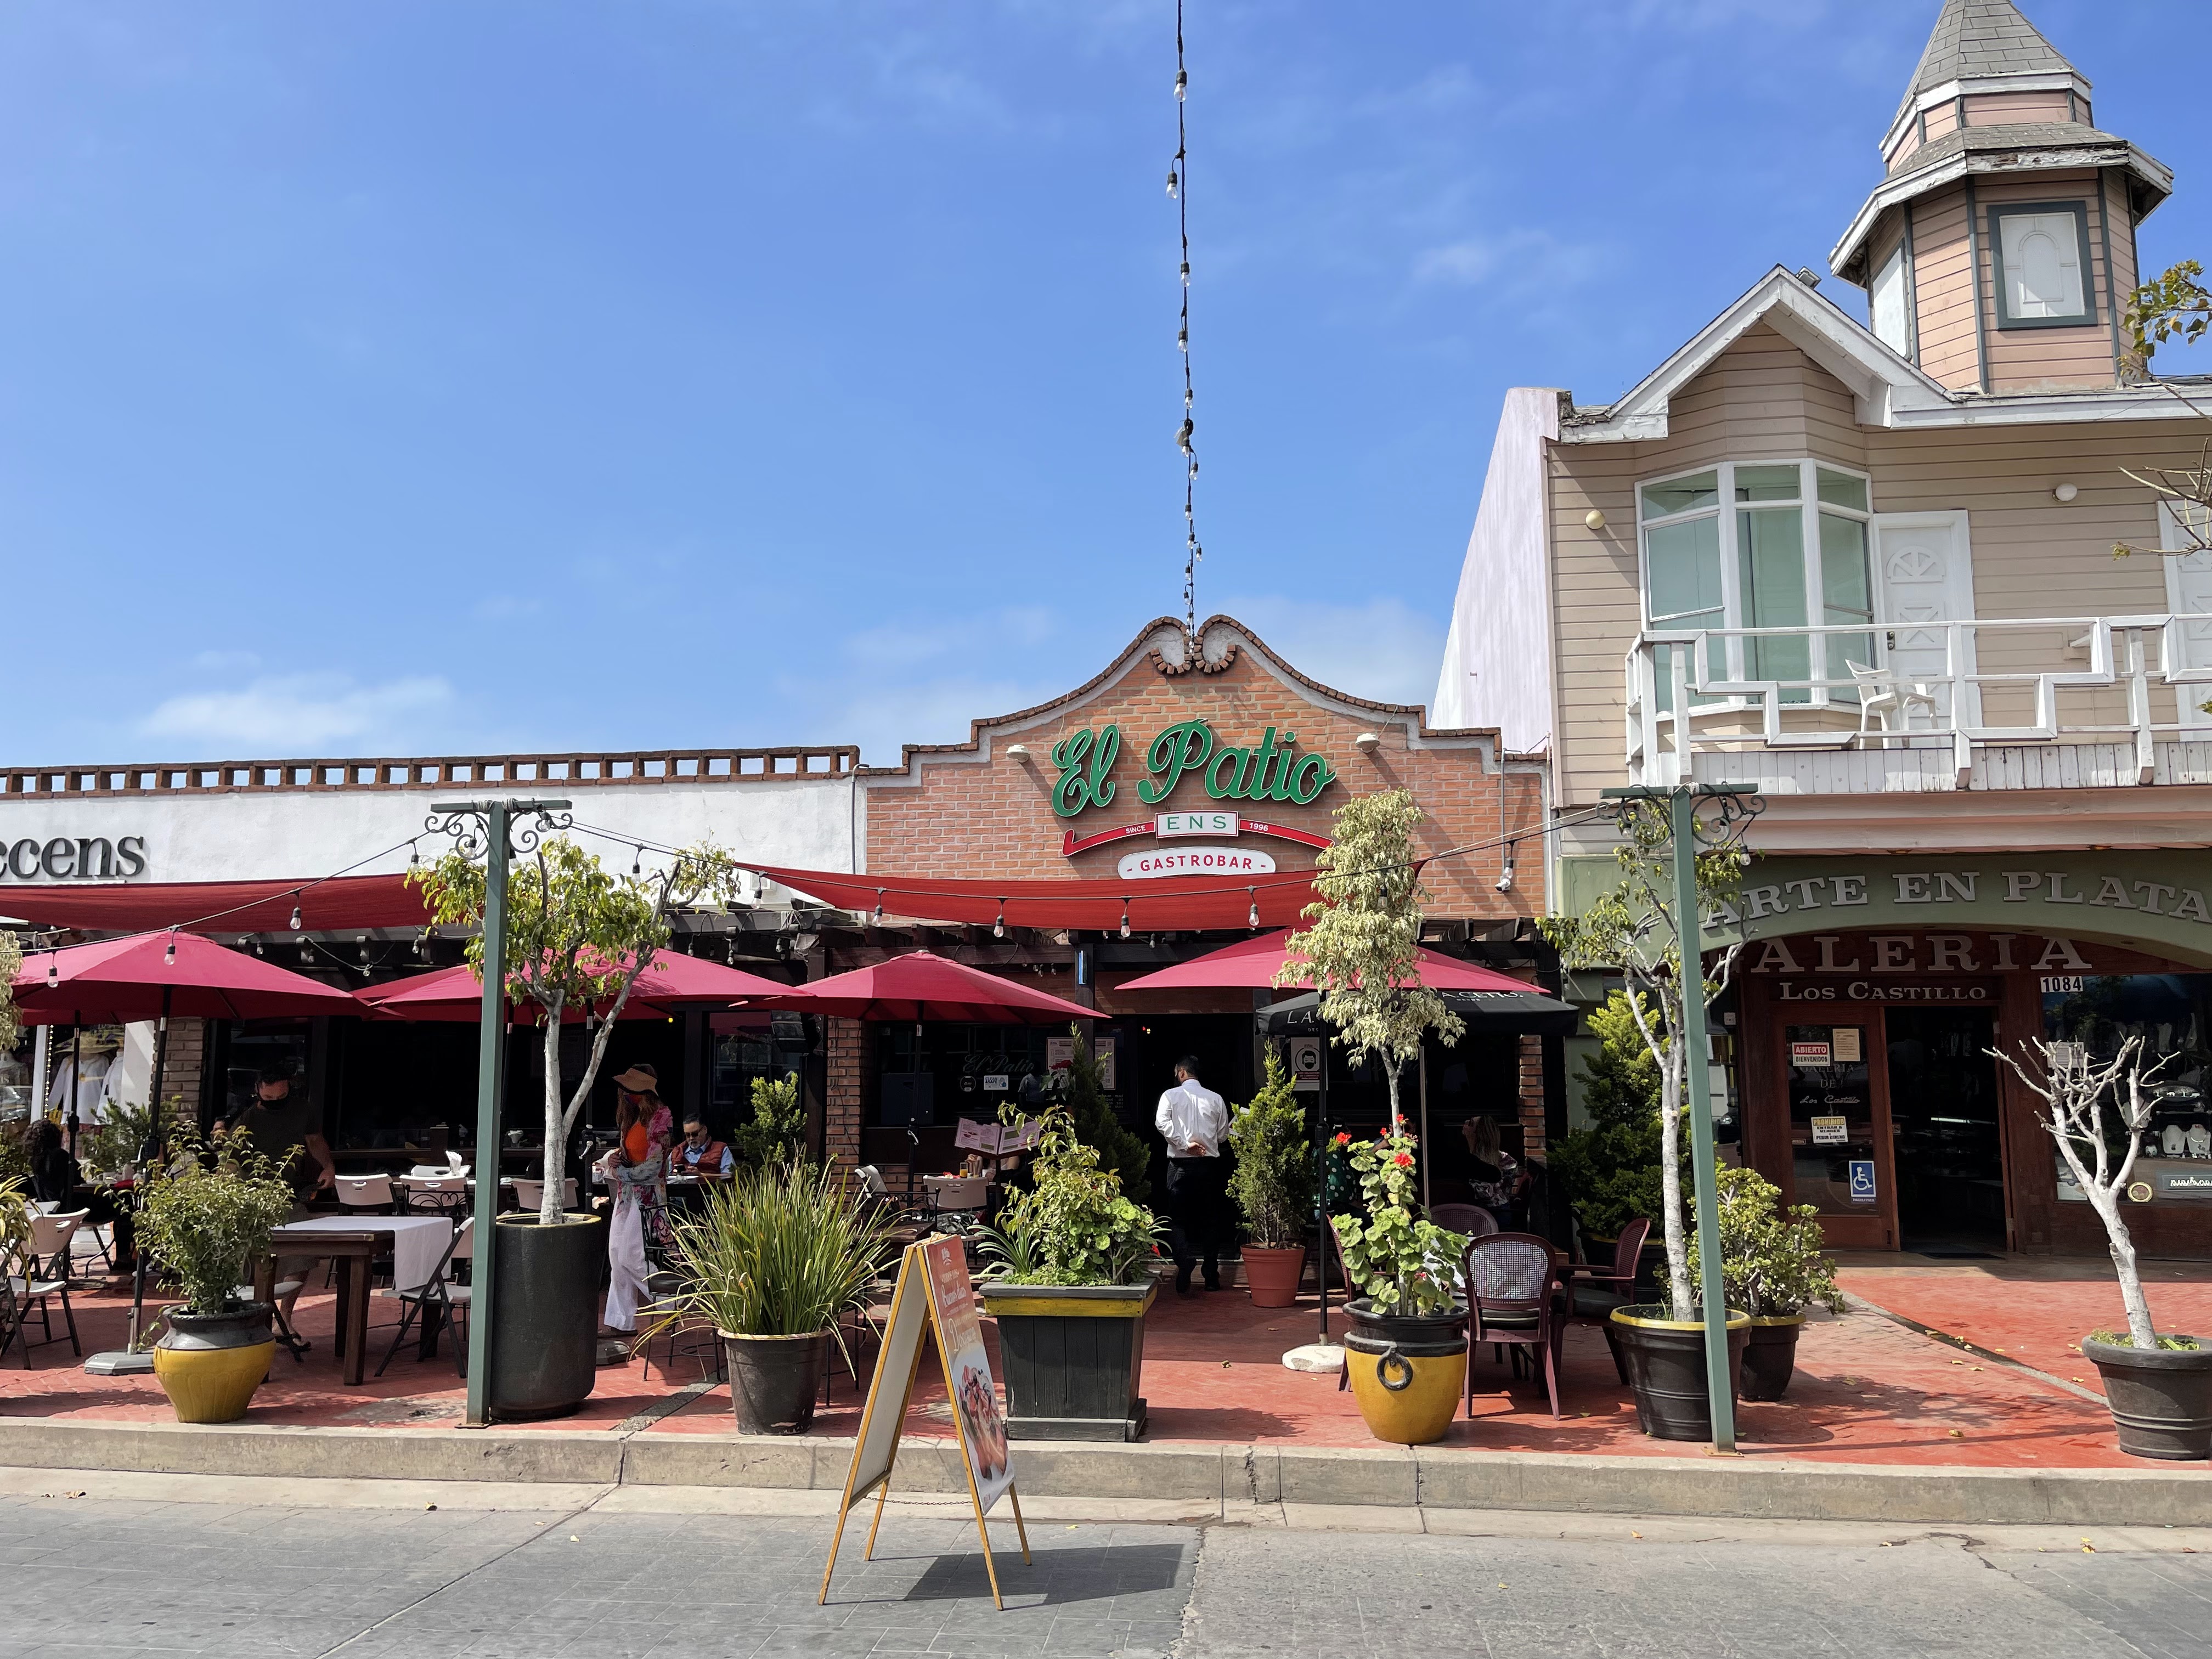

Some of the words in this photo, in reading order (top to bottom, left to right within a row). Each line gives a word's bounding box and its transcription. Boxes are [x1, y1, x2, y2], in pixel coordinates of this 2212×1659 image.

[1051, 724, 1120, 817] El
[1137, 718, 1338, 805] Patio
[1125, 825, 1146, 834] SINCE
[1249, 822, 1269, 832] 1996
[1167, 816, 1227, 830] ENS
[0, 836, 144, 879] cens
[1139, 854, 1252, 871] GASTROBAR
[1701, 875, 1868, 929] ARTE
[1892, 871, 1980, 904] EN
[2001, 871, 2212, 923] PLATA
[2042, 977, 2082, 992] 1084
[1820, 1079, 1836, 1088] DE
